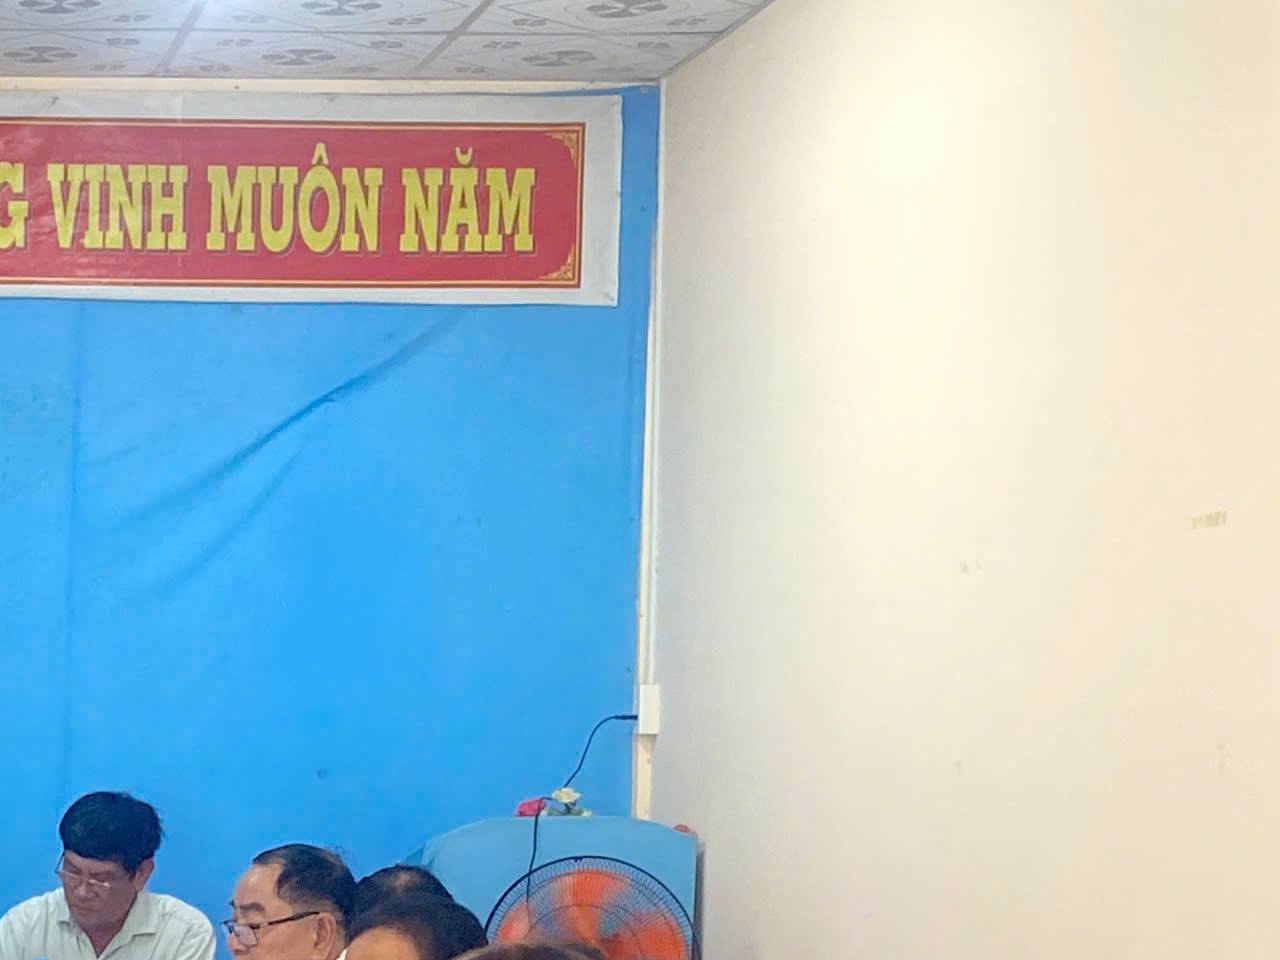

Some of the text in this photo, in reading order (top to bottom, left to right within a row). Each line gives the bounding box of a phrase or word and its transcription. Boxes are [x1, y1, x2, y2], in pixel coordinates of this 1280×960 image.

[46, 163, 188, 250] VINH
[206, 143, 383, 253] MUÔN
[400, 147, 535, 253] NĂM
